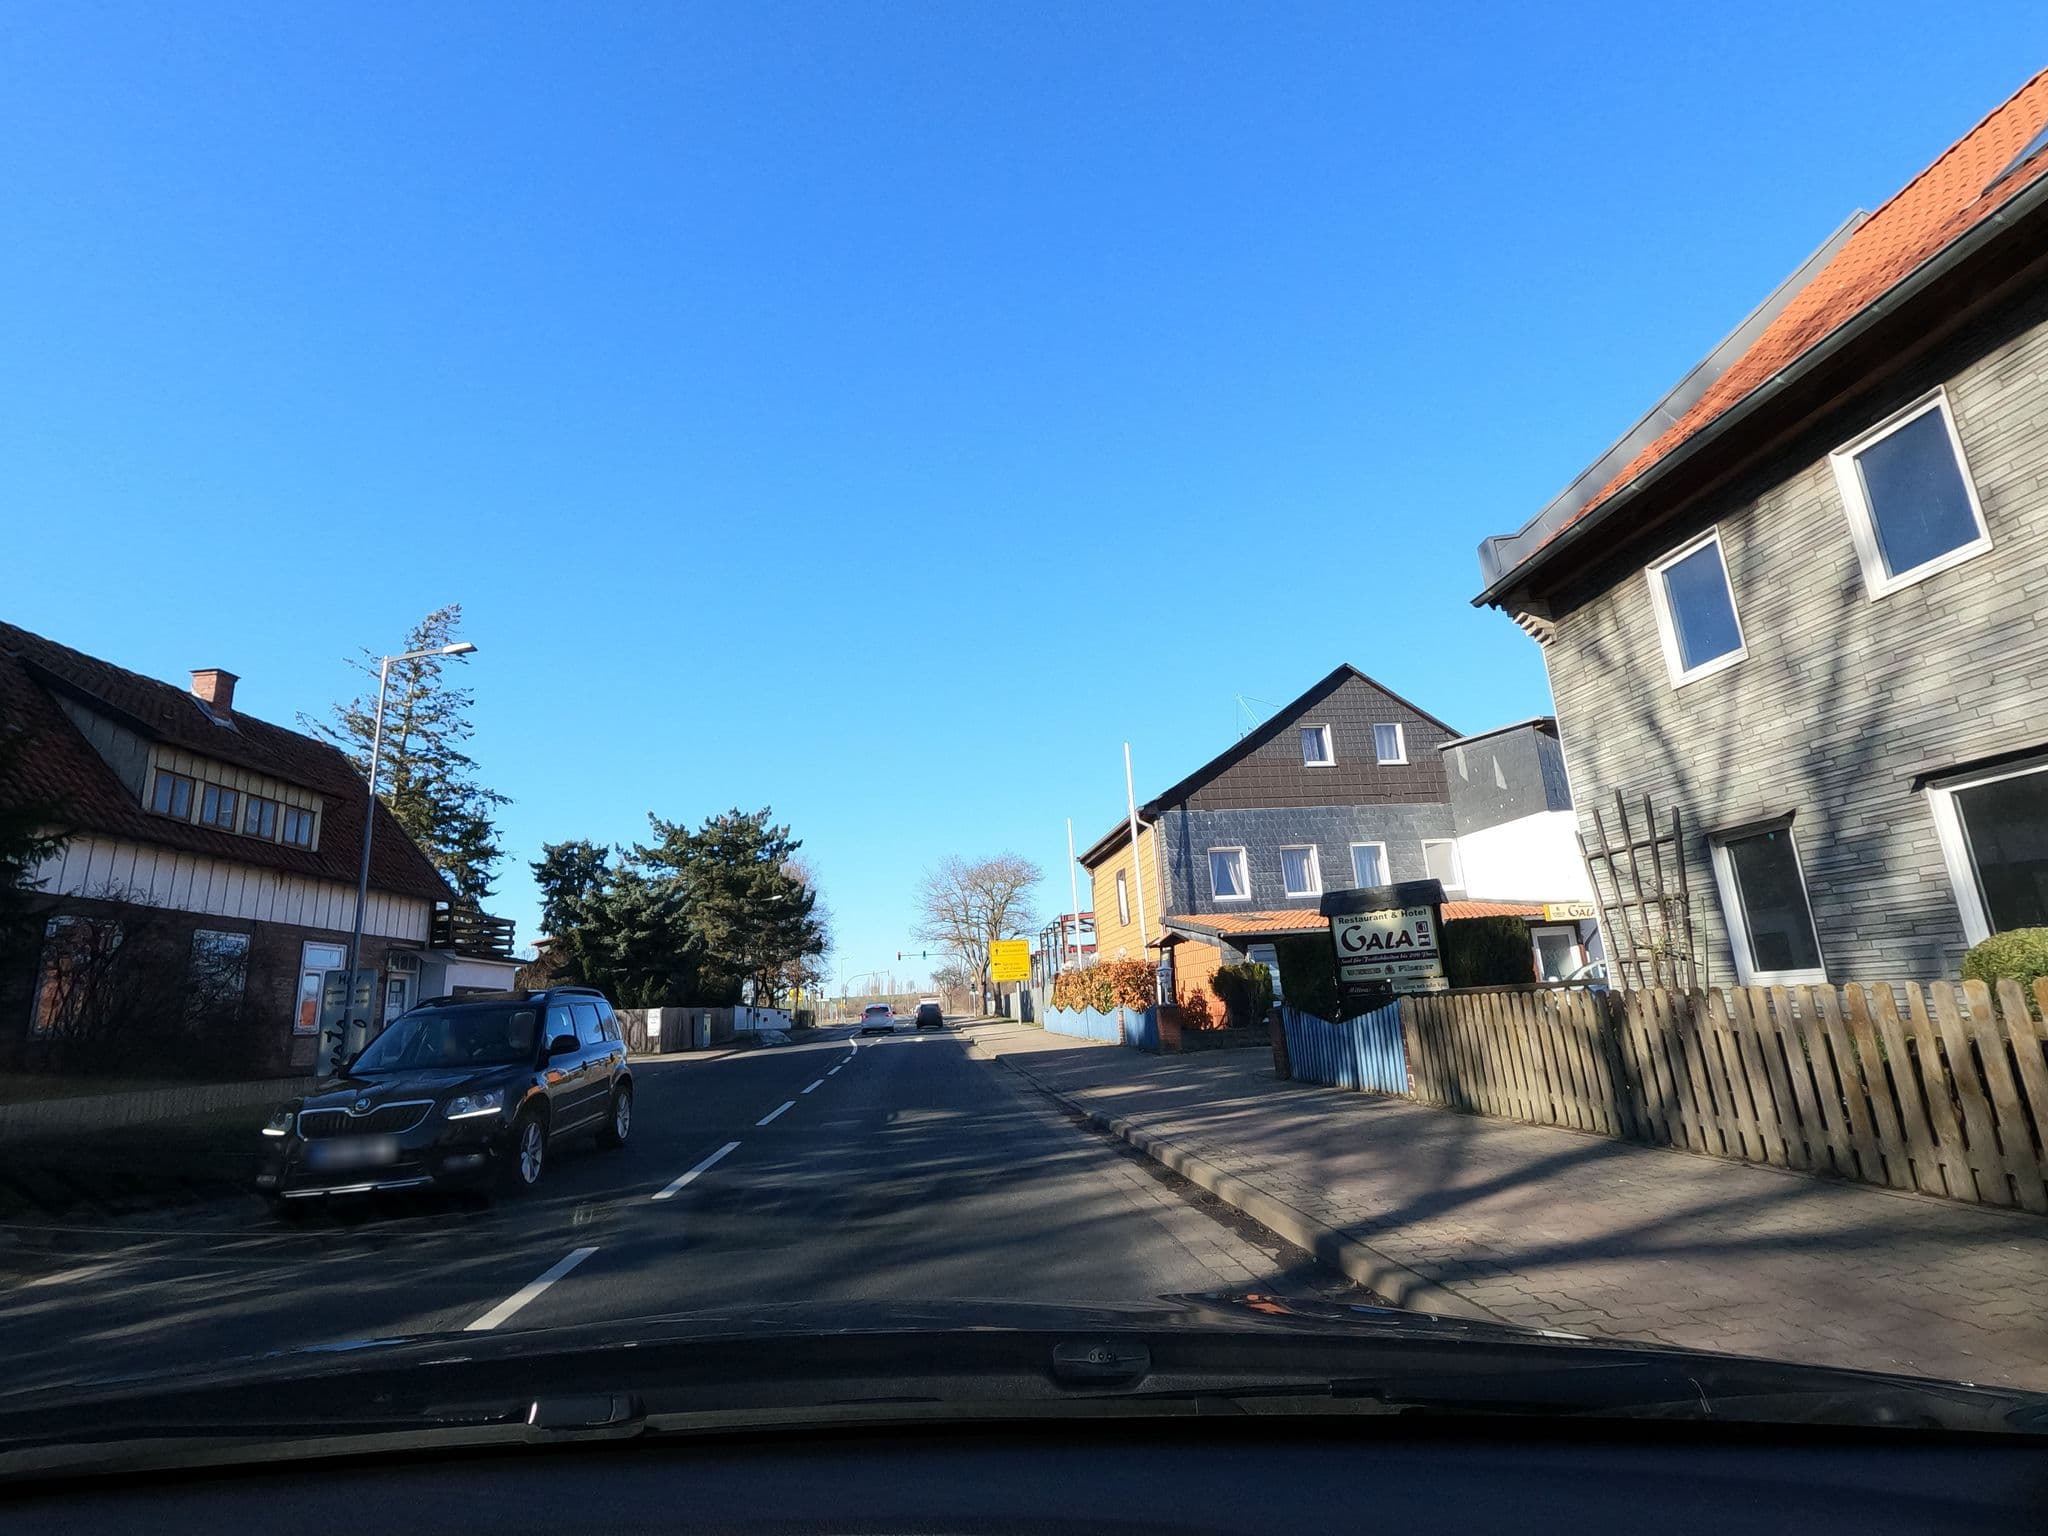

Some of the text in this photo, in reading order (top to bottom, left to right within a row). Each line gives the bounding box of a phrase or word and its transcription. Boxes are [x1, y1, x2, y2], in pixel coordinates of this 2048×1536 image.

[1338, 908, 1427, 925] Restaurant & Hotel
[1341, 925, 1414, 952] GALA
